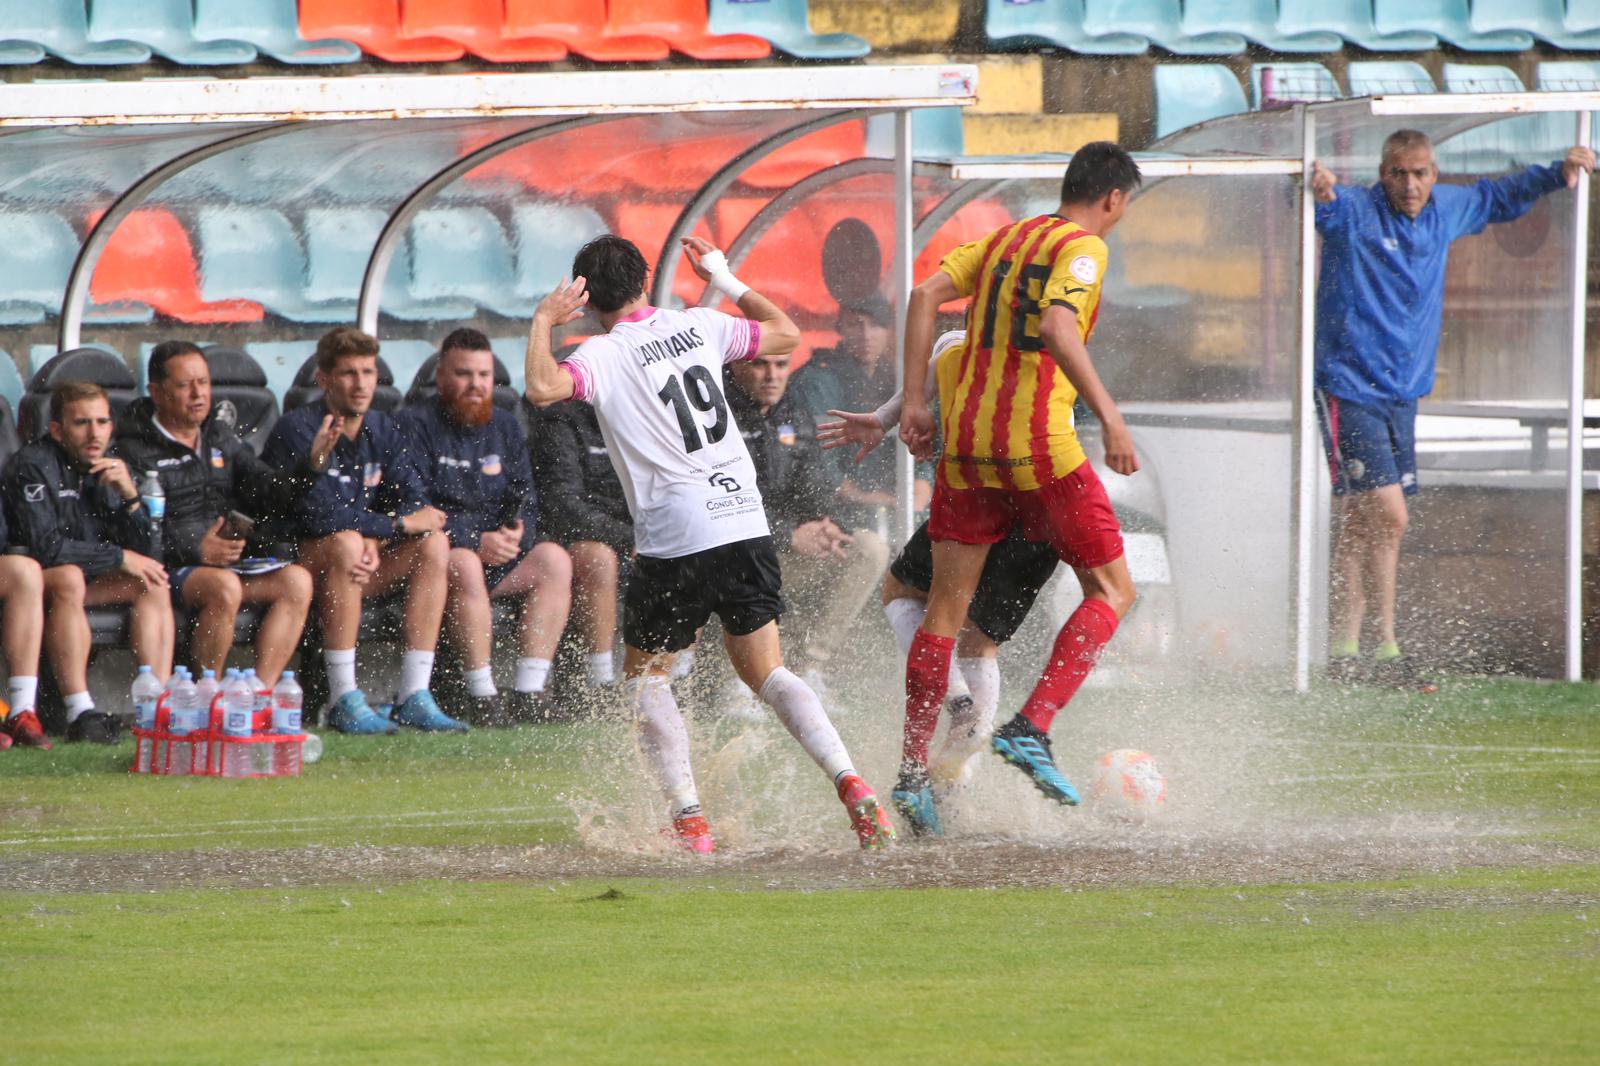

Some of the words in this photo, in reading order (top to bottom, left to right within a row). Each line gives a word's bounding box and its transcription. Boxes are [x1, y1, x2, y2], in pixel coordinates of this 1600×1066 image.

[982, 259, 1052, 352] 18
[658, 365, 728, 454] 19
[706, 499, 735, 511] CONDE
